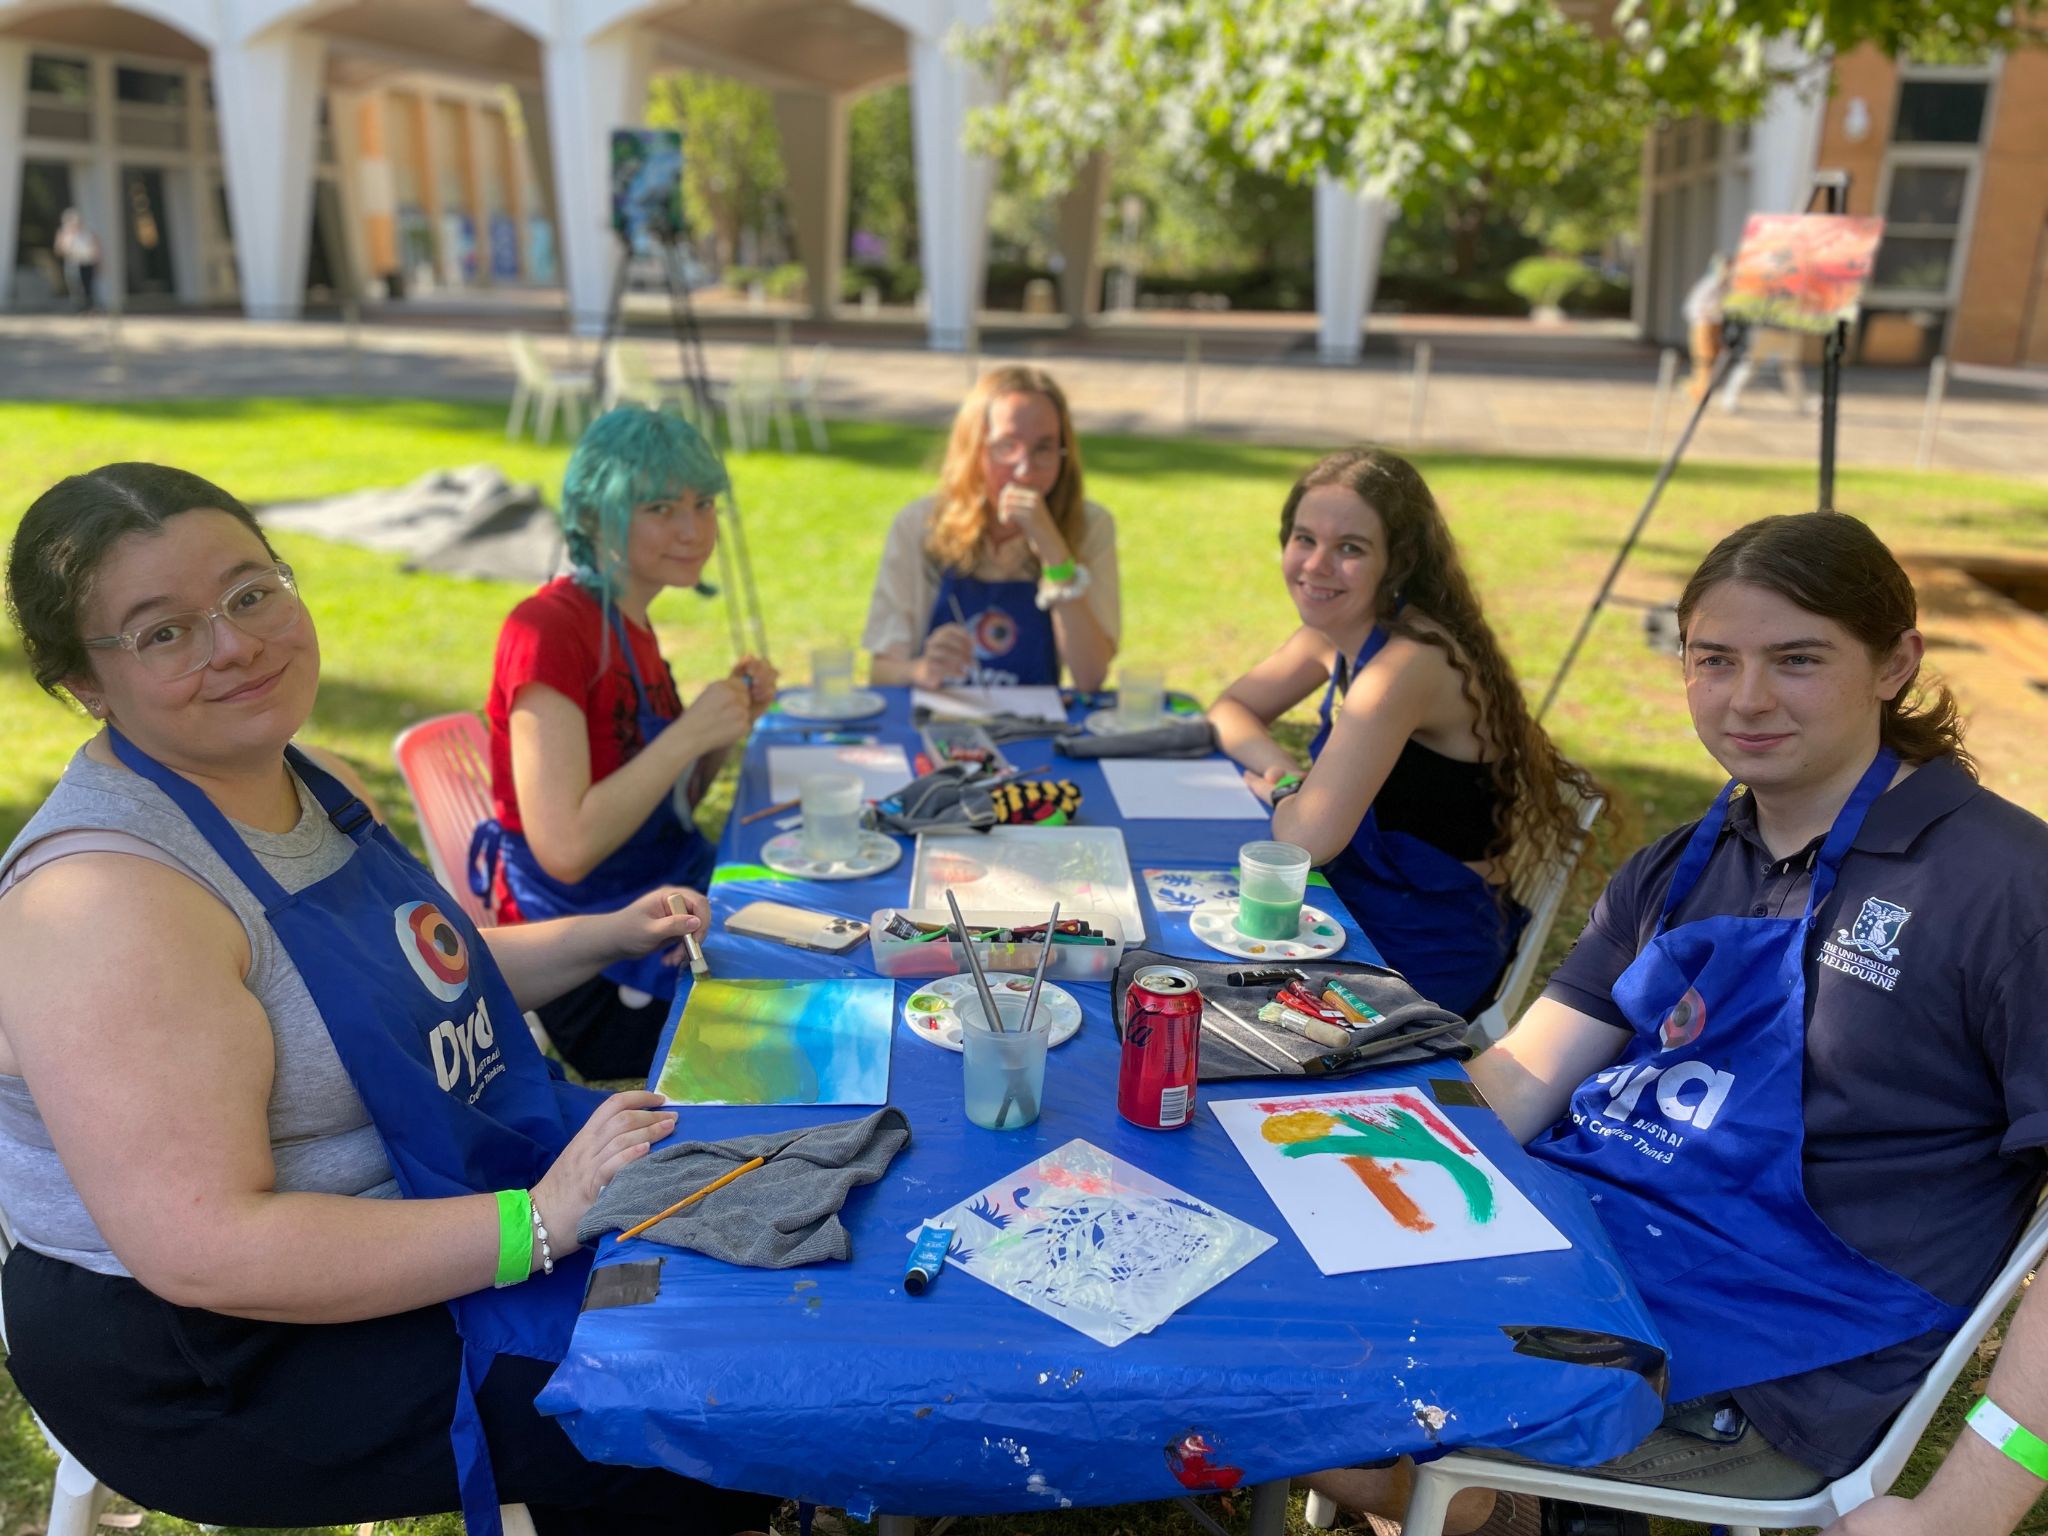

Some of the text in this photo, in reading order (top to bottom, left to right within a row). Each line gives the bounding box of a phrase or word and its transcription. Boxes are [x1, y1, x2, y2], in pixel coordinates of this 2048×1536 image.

[1817, 952, 1896, 991] MELBOURNE
[1822, 941, 1838, 954] THE
[1838, 946, 1889, 974] UNIVERSITY
[1887, 967, 1901, 978] OF
[1572, 1113, 1588, 1126] of
